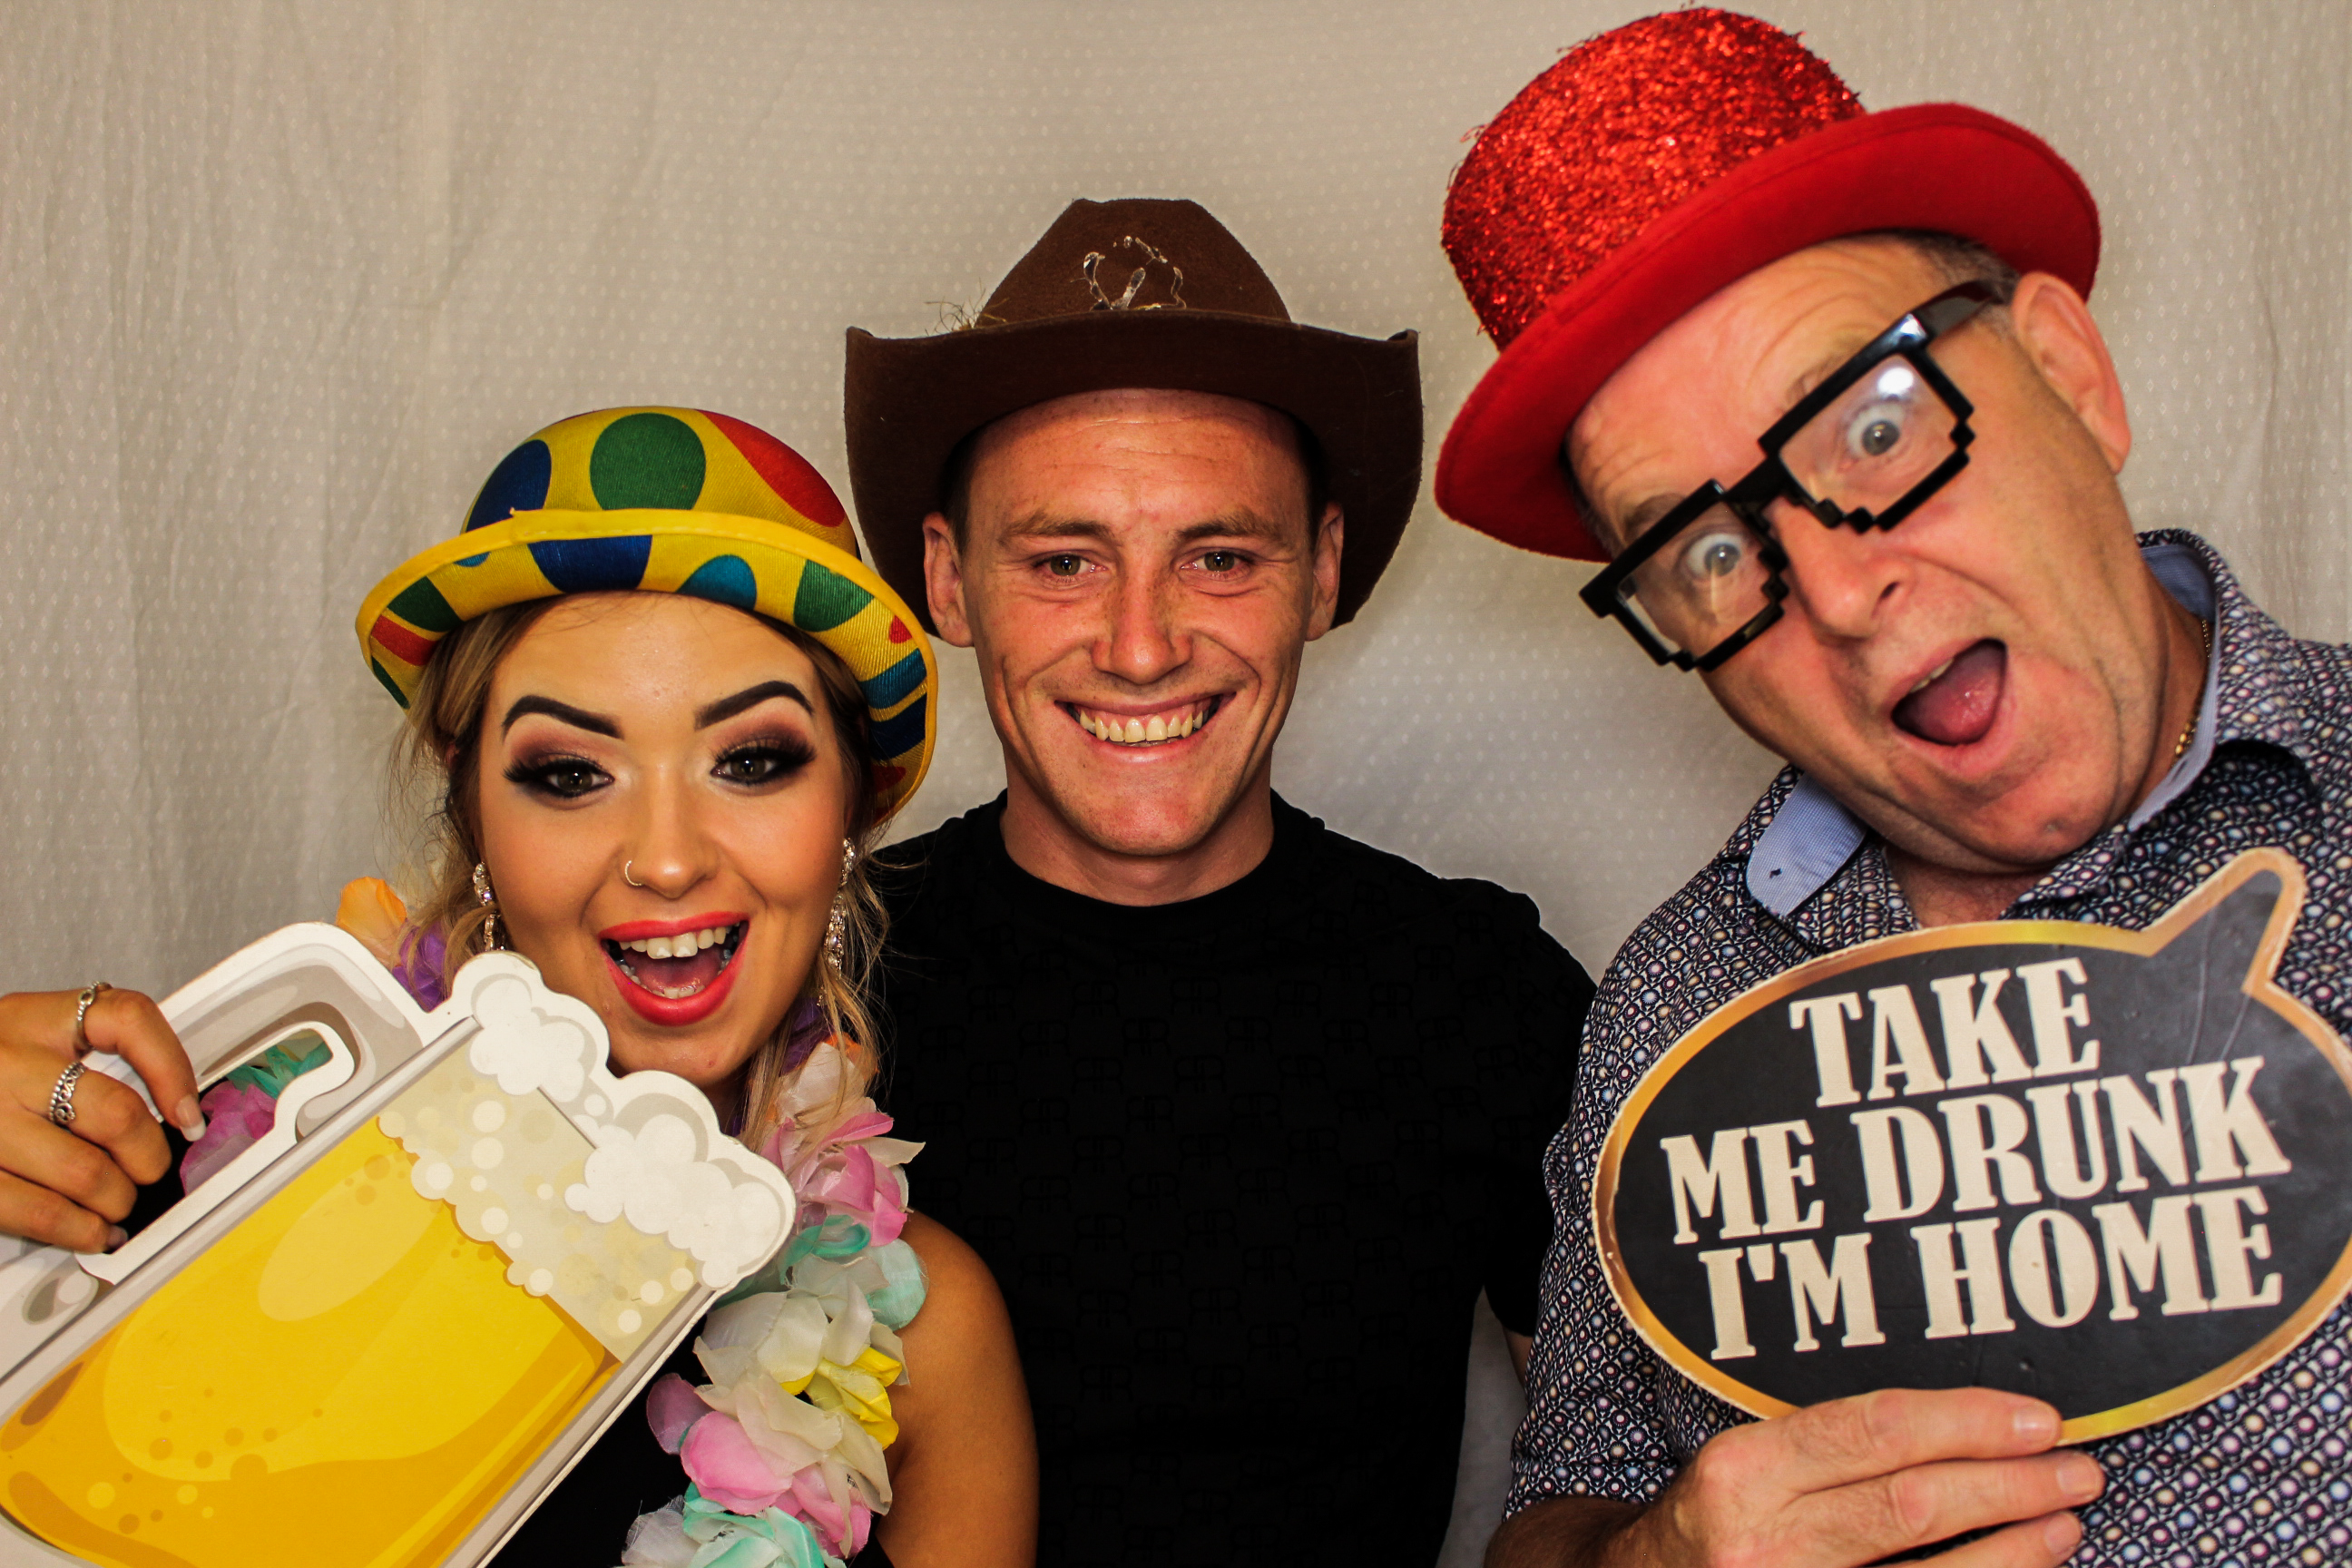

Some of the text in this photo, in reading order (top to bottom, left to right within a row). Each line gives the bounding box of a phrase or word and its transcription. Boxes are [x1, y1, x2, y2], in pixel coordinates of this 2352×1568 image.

[1788, 956, 2101, 1108] TAKE
[1660, 1055, 2292, 1245] ME DRUNK
[1698, 1185, 2283, 1360] I'M HOME
